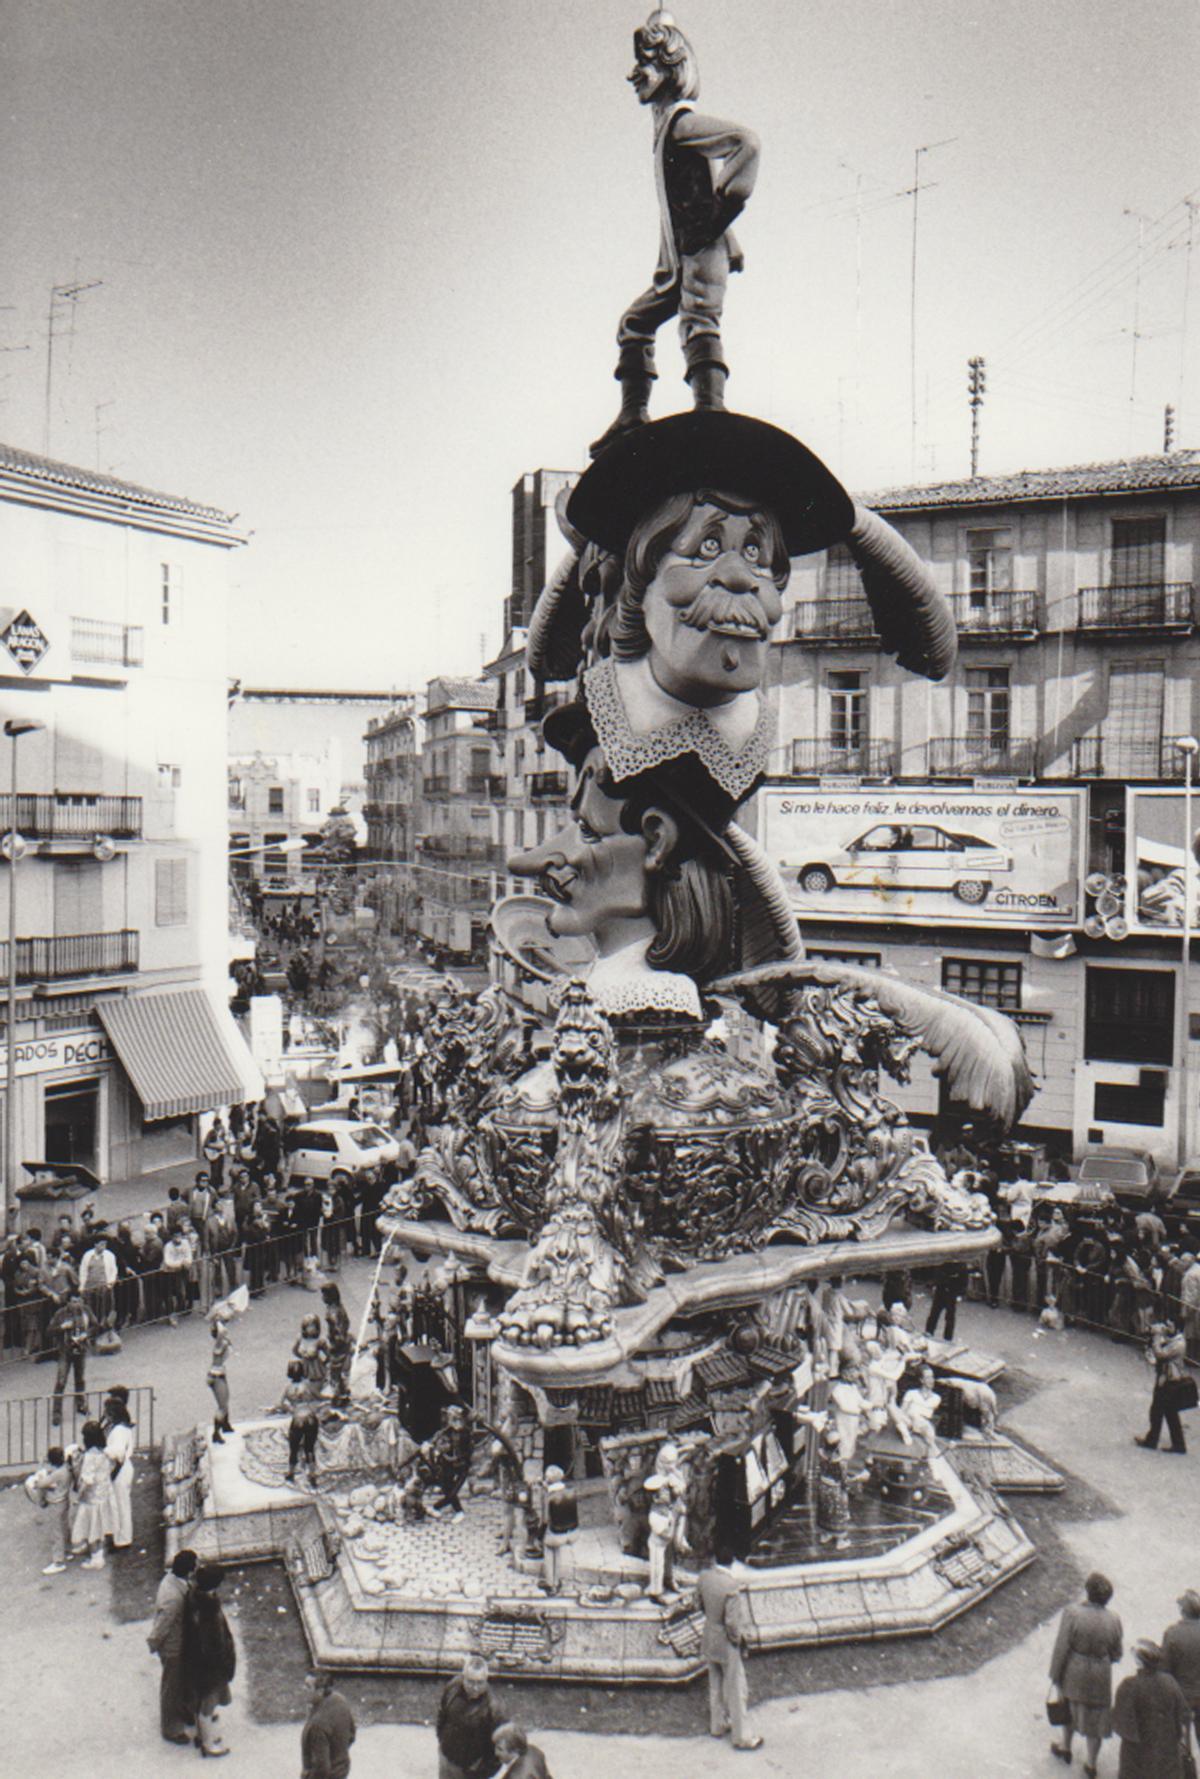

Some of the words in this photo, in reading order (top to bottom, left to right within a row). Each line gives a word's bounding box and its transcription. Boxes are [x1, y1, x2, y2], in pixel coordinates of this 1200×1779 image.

[780, 800, 794, 814] Si
[795, 804, 811, 814] no
[813, 801, 825, 814] le
[826, 801, 860, 814] hace
[894, 801, 906, 814] le
[908, 801, 993, 817] devolvemos
[997, 803, 1010, 817] el
[1012, 803, 1062, 817] dinero.
[0, 1042, 57, 1066] ADOS
